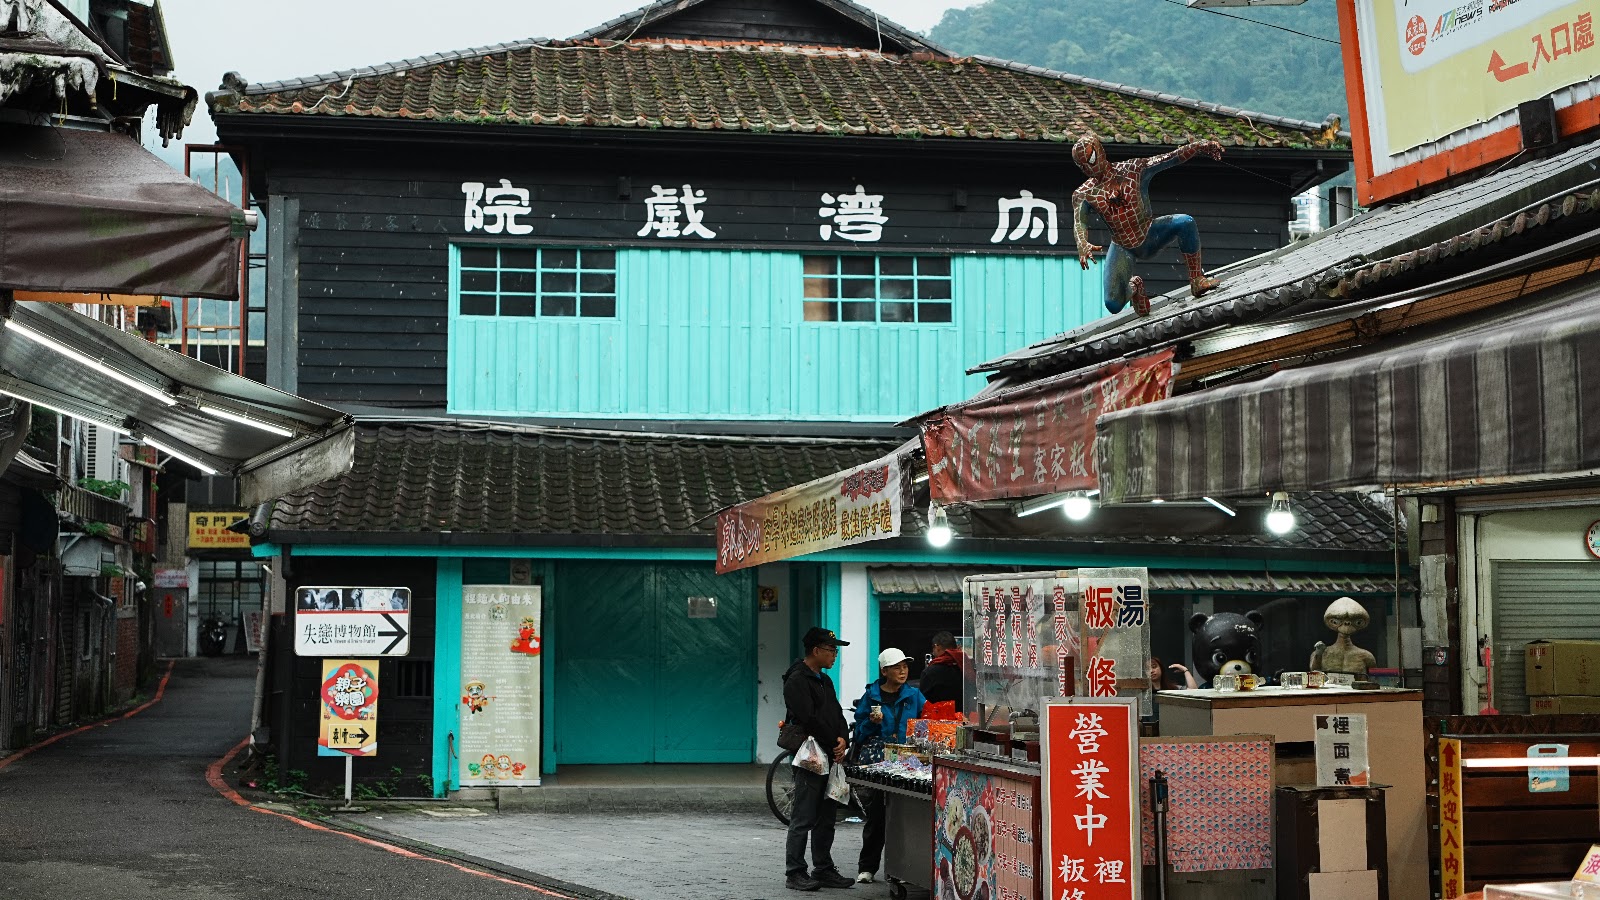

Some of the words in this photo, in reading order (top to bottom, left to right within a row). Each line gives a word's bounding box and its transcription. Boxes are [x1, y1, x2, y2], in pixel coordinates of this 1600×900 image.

[1531, 11, 1595, 71] 入口處
[1010, 585, 1023, 668] 湯粄條
[1115, 584, 1145, 628] 湯
[303, 623, 376, 645] 失戀博物館
[1084, 585, 1118, 697] 粄條
[334, 691, 365, 706] 樂園
[335, 676, 367, 692] 親子
[1332, 716, 1351, 785] 裡面煮
[1068, 712, 1110, 847] 營業中
[1094, 856, 1126, 884] 裡
